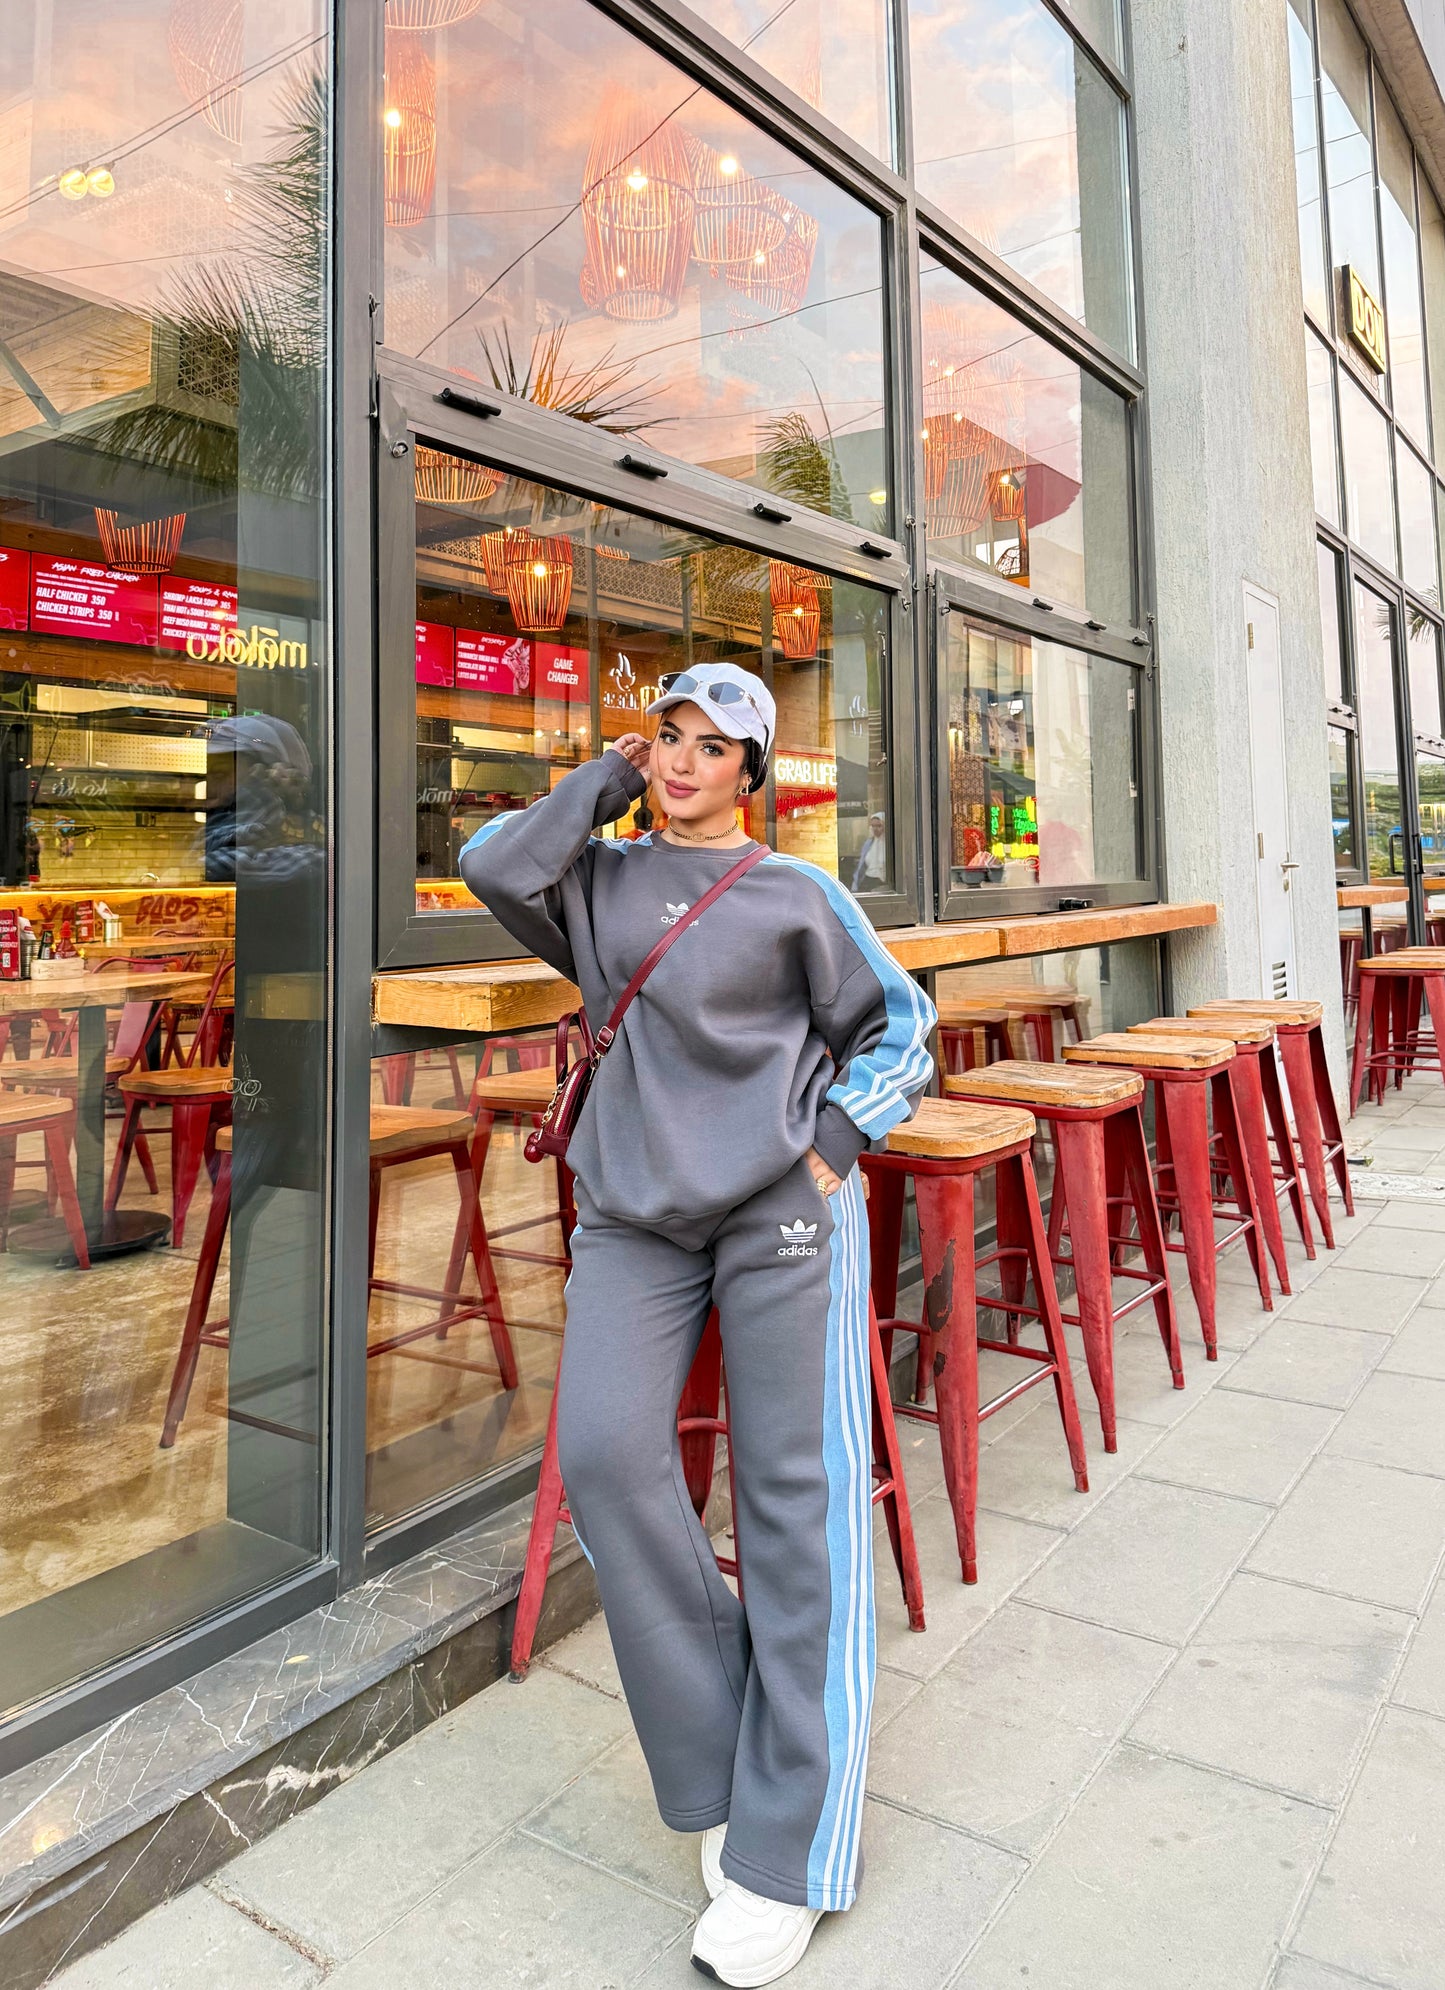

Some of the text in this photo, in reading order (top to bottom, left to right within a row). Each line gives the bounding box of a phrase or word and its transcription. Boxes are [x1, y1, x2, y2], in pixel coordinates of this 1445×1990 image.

[51, 562, 141, 582] ASIAN FRIED CHICKEN
[36, 586, 106, 606] HALF CHICKEN 350
[188, 585, 212, 596] SOUPS
[203, 598, 218, 607] SOUP
[36, 600, 112, 620] CHICKEN STRIPS 350
[553, 657, 574, 671] GAME
[547, 671, 579, 685] CHANGER
[774, 758, 838, 786] GRAB LIFE
[777, 1244, 818, 1256] adidas
